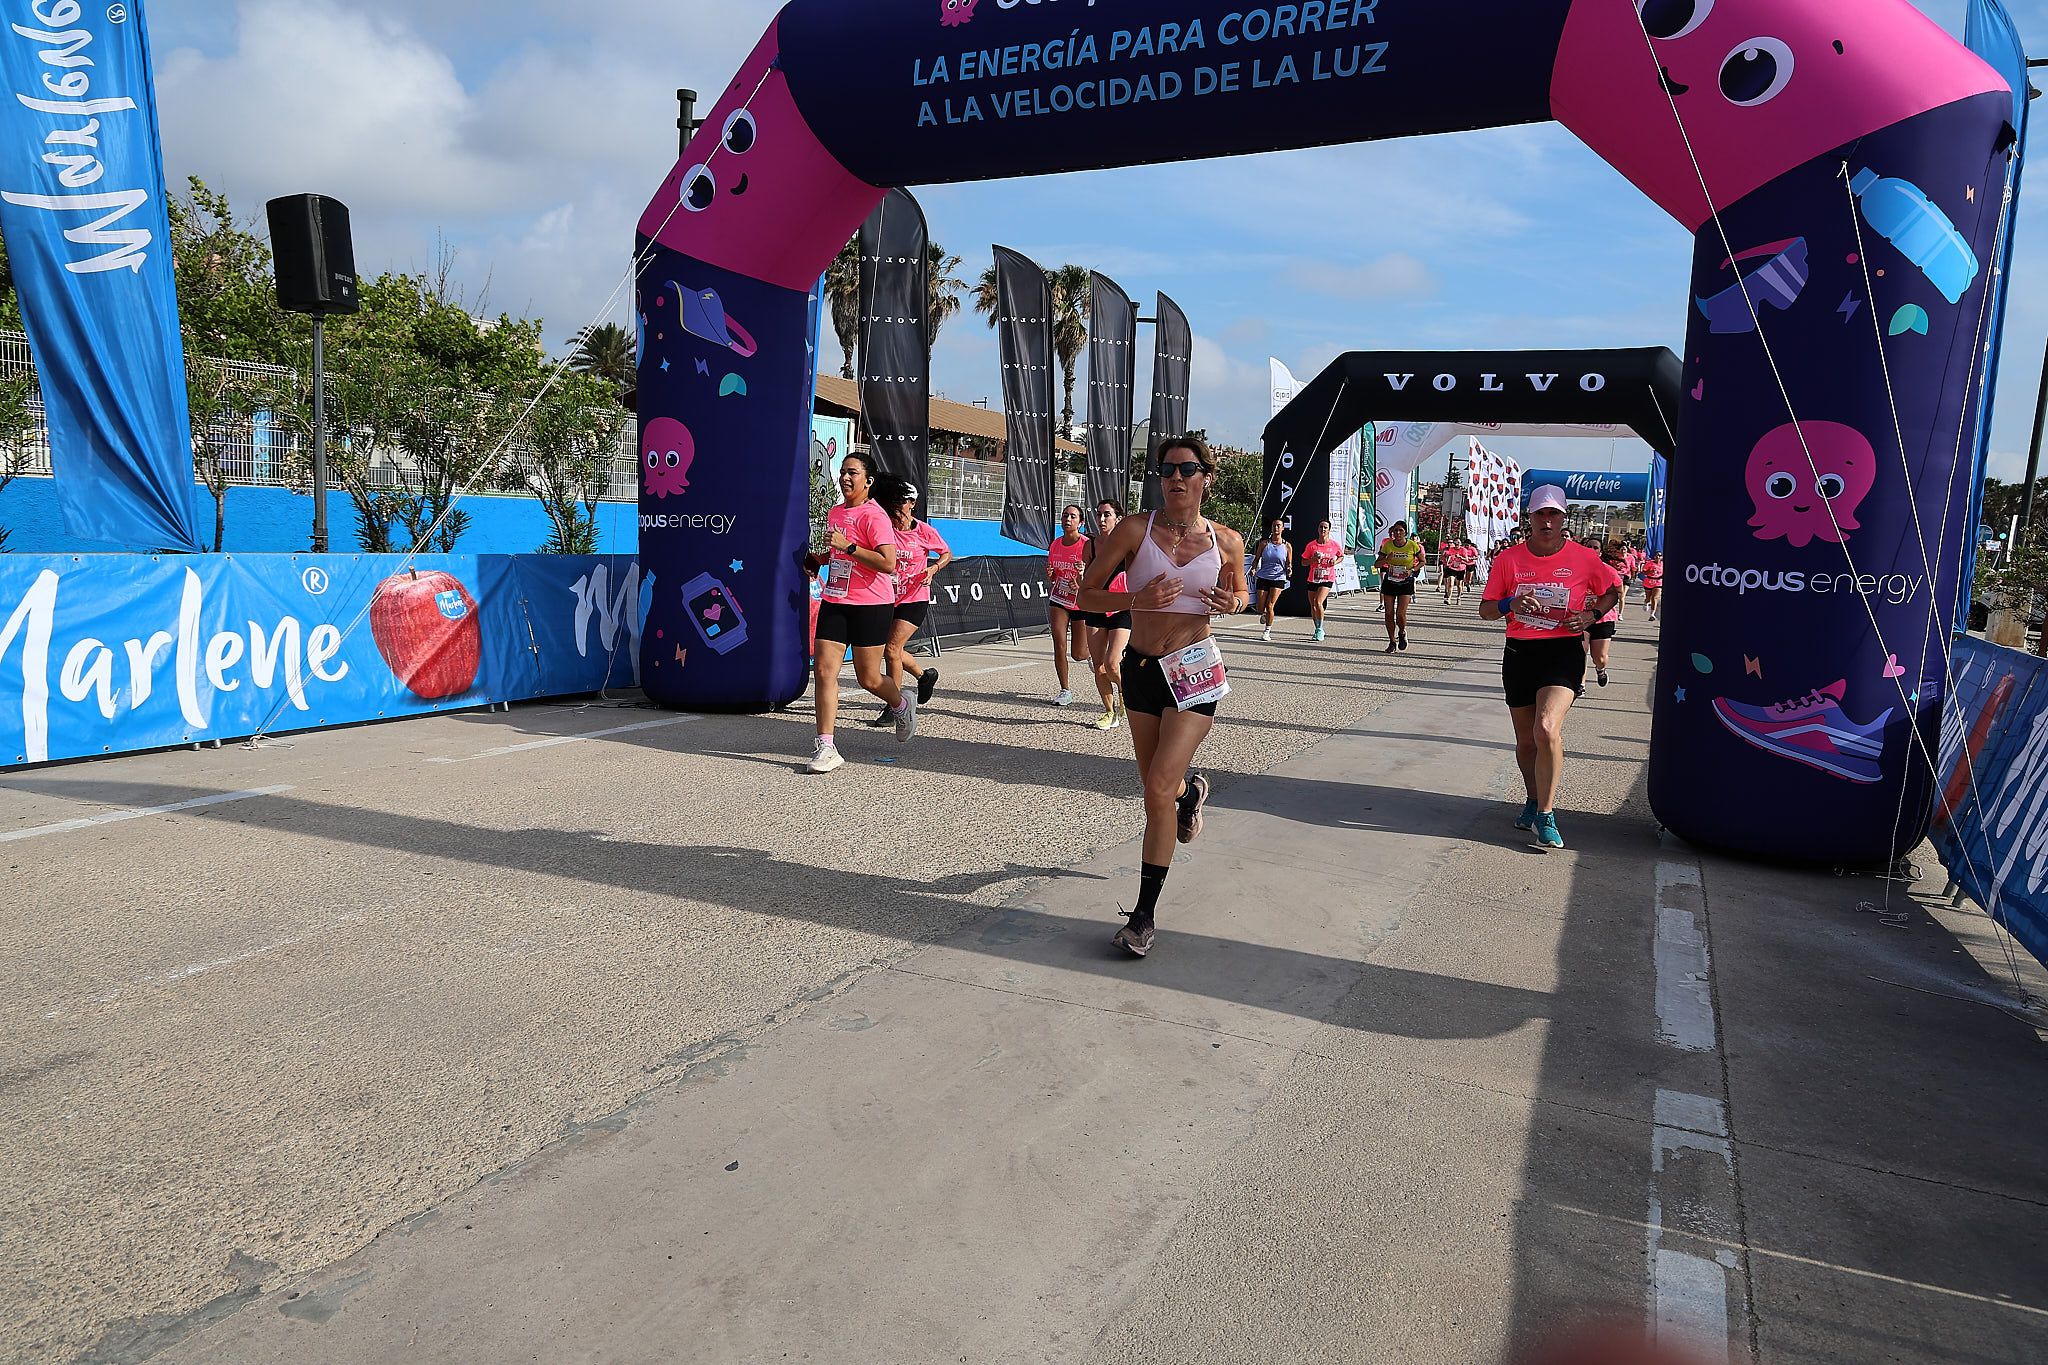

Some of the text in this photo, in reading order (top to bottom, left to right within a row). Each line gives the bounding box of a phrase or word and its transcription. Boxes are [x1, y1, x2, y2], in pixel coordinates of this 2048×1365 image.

[913, 0, 1379, 86] LA ENERGÍA PARA CORRER
[917, 41, 1389, 127] A LA VELOCIDAD DE LA LUZ
[1, 0, 153, 274] Marlene
[1383, 373, 1605, 392] VOLVO
[1565, 473, 1621, 496] Marlene
[668, 514, 736, 534] energy
[1000, 581, 1049, 600] VOL
[1685, 563, 1923, 604] octopus energy
[1189, 669, 1212, 685] 016
